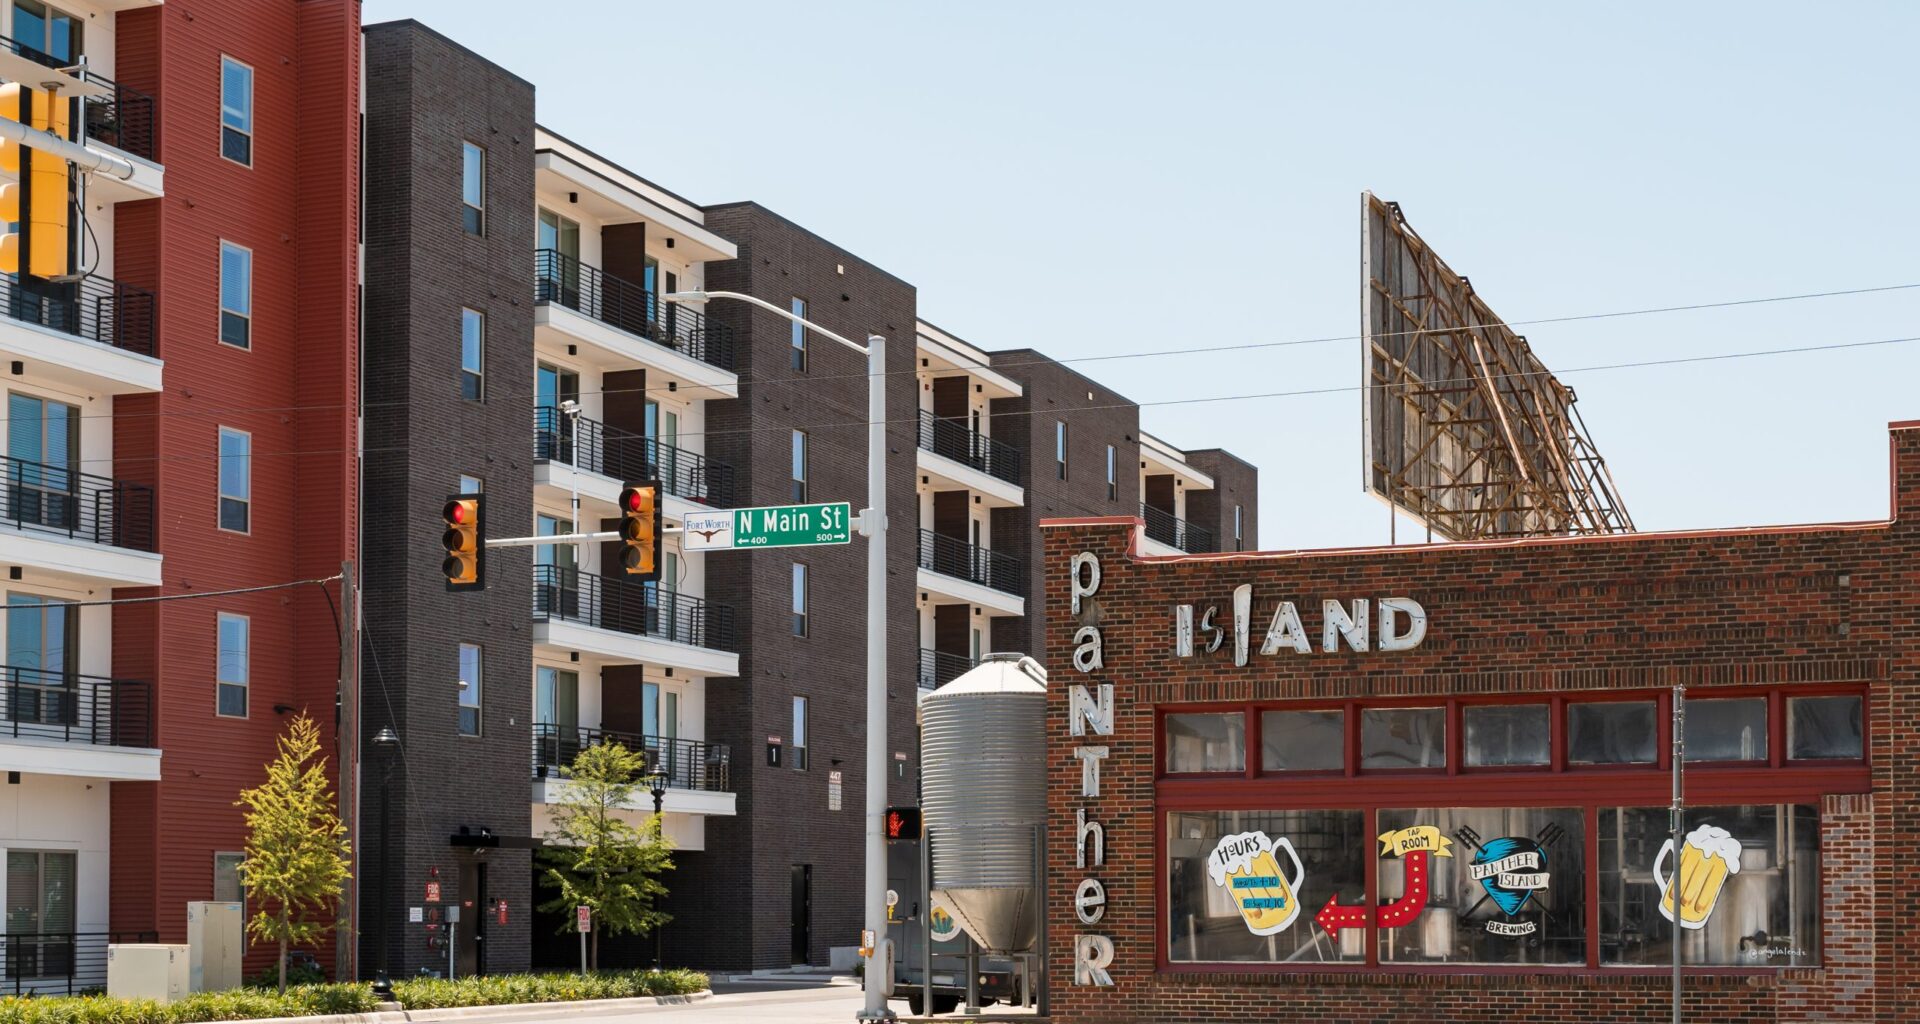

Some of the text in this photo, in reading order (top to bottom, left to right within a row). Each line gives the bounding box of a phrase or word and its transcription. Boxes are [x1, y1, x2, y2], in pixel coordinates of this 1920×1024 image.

[740, 506, 841, 533] N Main St
[750, 536, 768, 545] 400
[816, 533, 833, 542] 500
[772, 747, 777, 763] 1
[899, 763, 903, 777] 1
[1407, 829, 1421, 837] TAP
[1401, 835, 1431, 850] ROOM
[1472, 852, 1534, 879] PANTHER
[1500, 873, 1541, 887] ISLAND
[1488, 922, 1533, 934] BREWING
